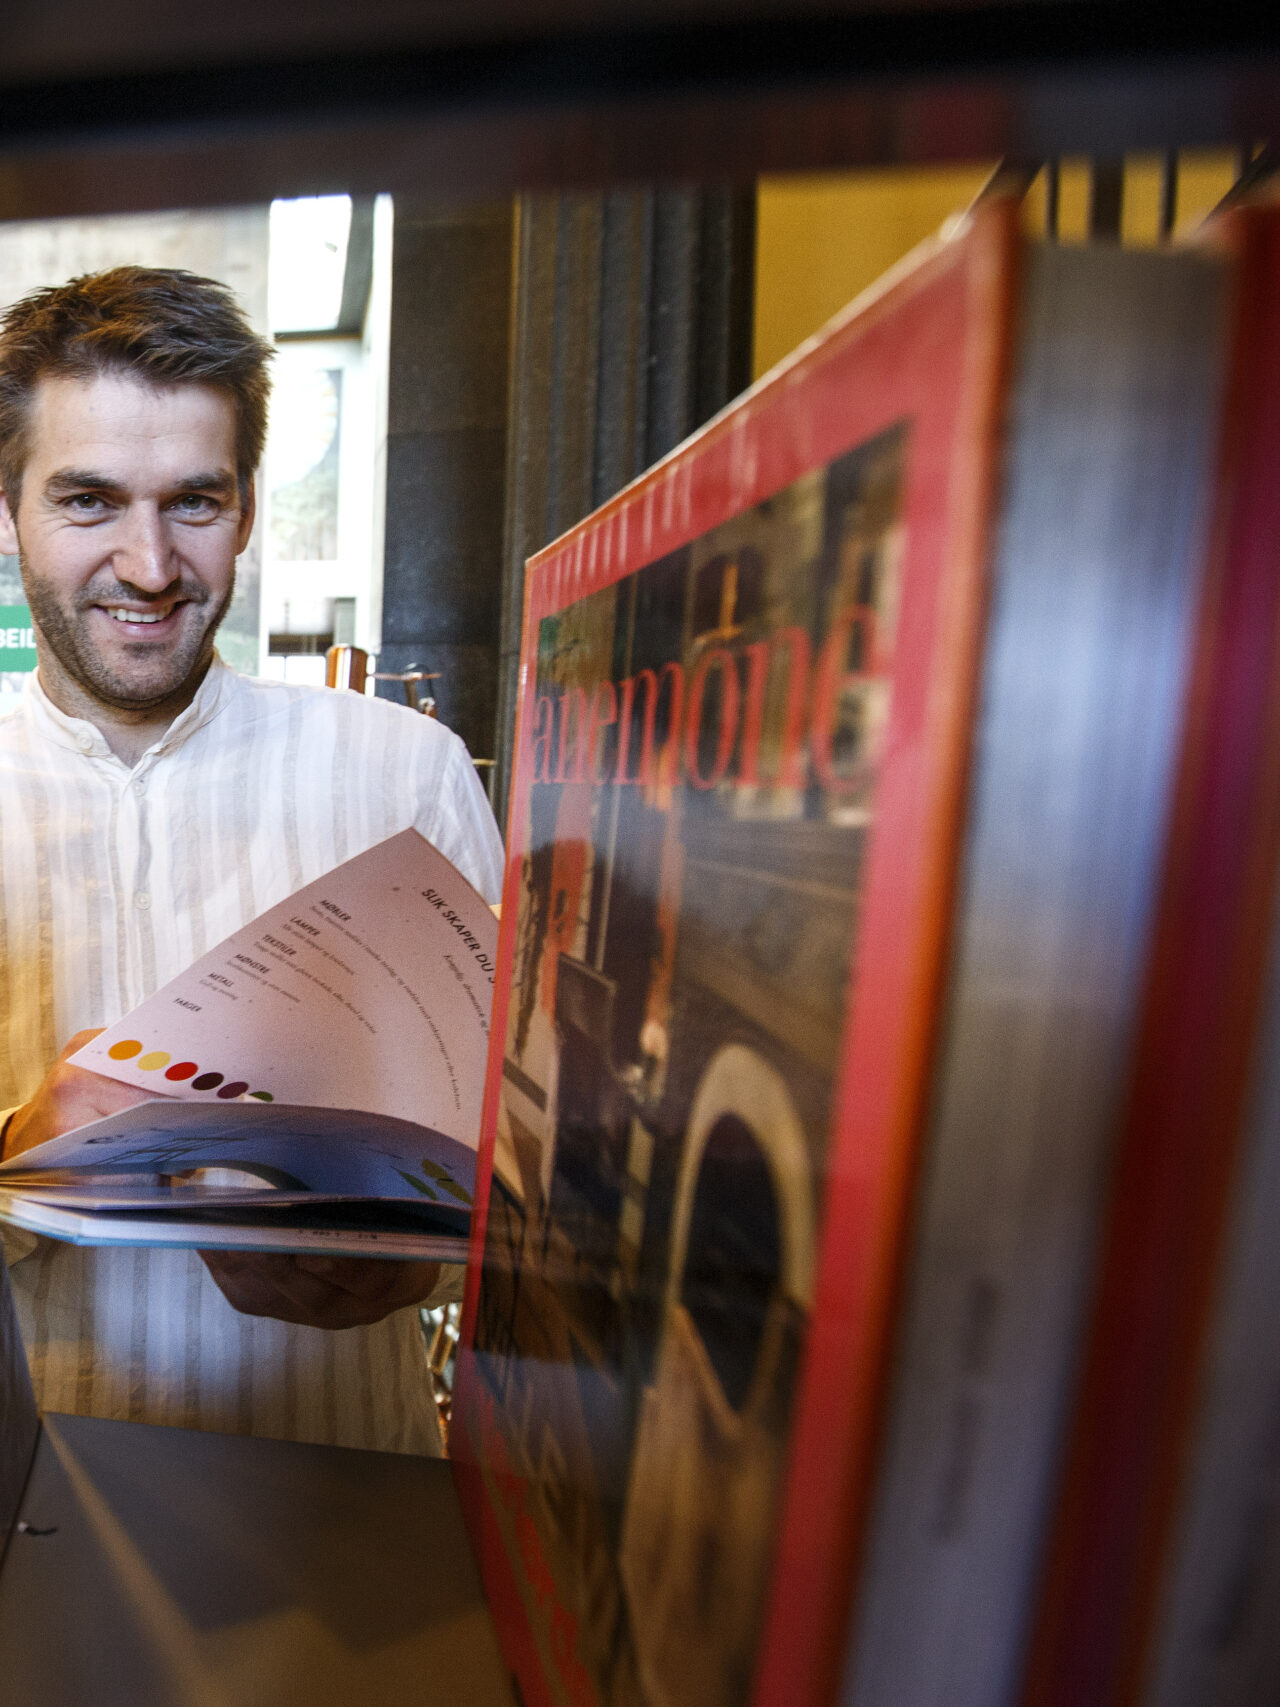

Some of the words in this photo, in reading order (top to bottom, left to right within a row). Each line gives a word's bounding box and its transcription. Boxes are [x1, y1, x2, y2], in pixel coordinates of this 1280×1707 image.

[320, 899, 352, 922] MØBLER
[290, 916, 321, 936] LAMPER
[421, 888, 448, 910] SLIK
[441, 910, 481, 952] SKAPER
[475, 953, 494, 973] DU
